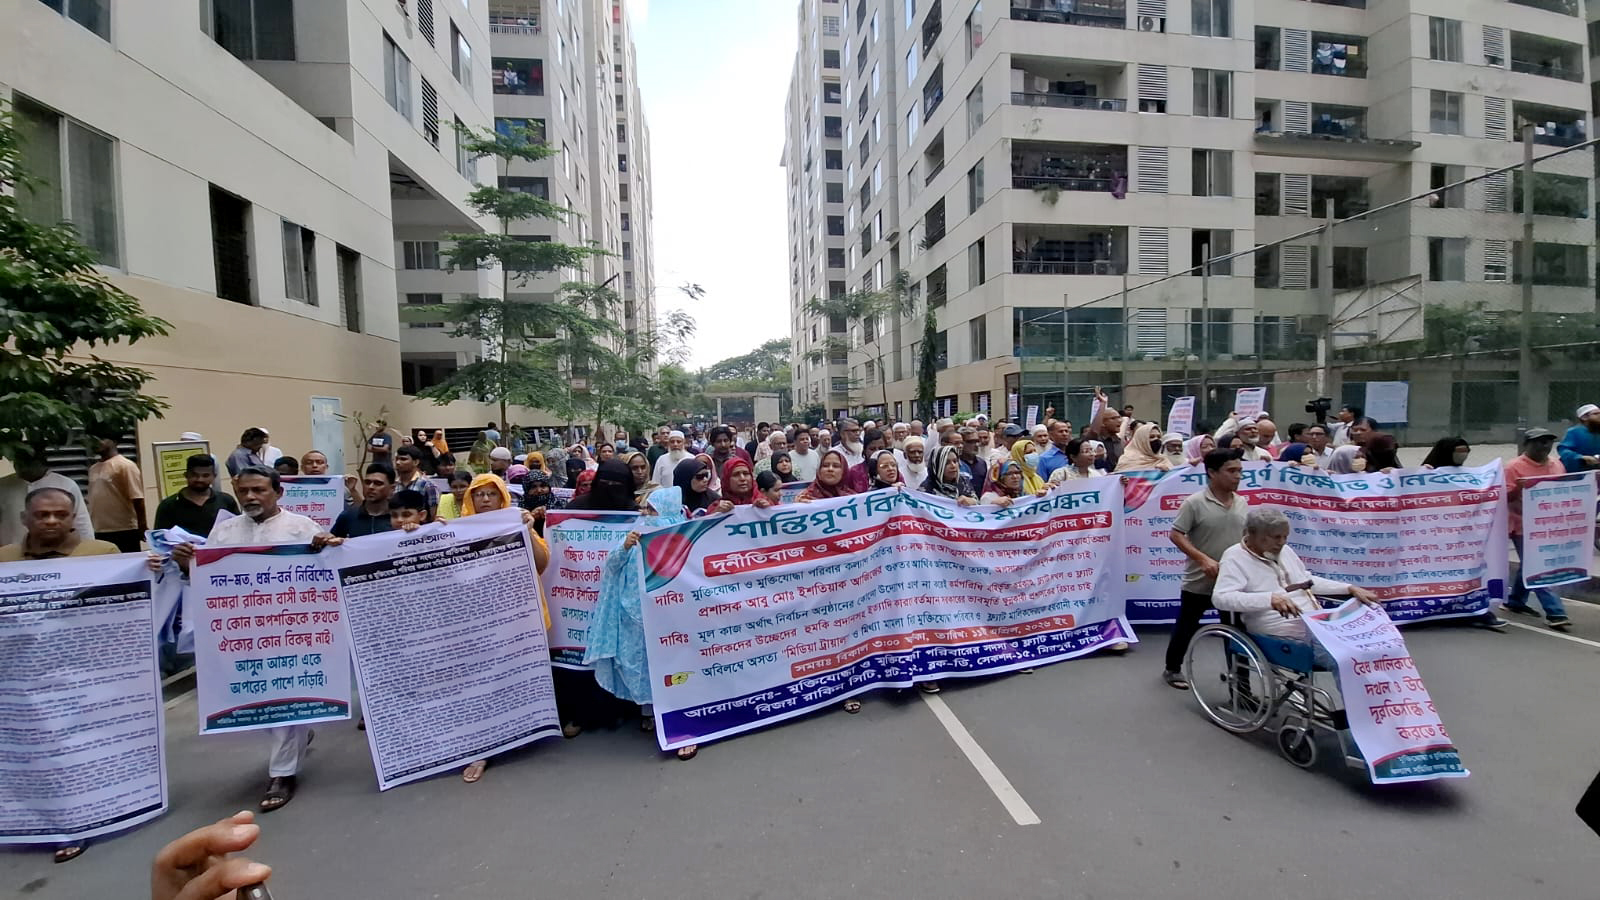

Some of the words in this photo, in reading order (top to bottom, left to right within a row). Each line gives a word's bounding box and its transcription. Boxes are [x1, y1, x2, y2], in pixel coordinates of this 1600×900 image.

[724, 498, 858, 538] শান্তিপূর্ণ
[964, 511, 985, 523] ও
[425, 531, 456, 544] আলো
[587, 525, 612, 543] সমিতির
[710, 546, 806, 574] দুর্নীতিবাজ
[812, 543, 828, 553] ও
[833, 527, 886, 550] ক্ষমতার
[1050, 516, 1078, 531] বিচার
[1083, 513, 1108, 525] চাই
[586, 550, 595, 561] ৭০
[19, 572, 62, 584] আলো
[210, 573, 253, 587] দল-মত,
[295, 563, 335, 583] নির্বিশেষে
[655, 591, 685, 607] দাবিঃ
[691, 581, 741, 601] মুক্তিযোদ্ধা
[743, 581, 753, 589] ও
[756, 571, 804, 590] মুক্তিযোদ্ধা
[808, 562, 841, 579] পরিবার
[895, 544, 908, 553] ৭০
[206, 597, 239, 609] আমরা
[242, 590, 272, 608] রাকিন
[276, 586, 297, 604] বাসী
[299, 586, 338, 605] ভাই-ভাই
[698, 600, 742, 617] প্রশাসক
[745, 595, 769, 608] আবু
[773, 590, 795, 604] মোঃ
[797, 580, 847, 599] ইশতিয়াক
[210, 619, 222, 632] যে
[227, 616, 251, 630] কোন
[254, 608, 308, 628] অপশক্তিকে
[312, 610, 340, 624] রুখতে
[660, 632, 689, 647] দাবিঃ
[697, 630, 716, 643] মূল
[719, 623, 742, 636] কাজ
[745, 616, 773, 630] অর্থাৎ
[775, 609, 808, 625] নির্বাচন
[811, 599, 854, 618] অনুষ্ঠানের
[218, 636, 253, 652] ঐক্যের
[257, 635, 281, 650] কোন
[285, 629, 312, 647] বিকল্প
[700, 638, 752, 657] মালিকদের
[755, 628, 797, 646] উচ্ছেদের
[804, 620, 830, 634] হুমকি
[701, 660, 744, 677] অবিলম্বে
[747, 651, 778, 667] অসত্য
[861, 620, 880, 636] মিথ্যা
[235, 658, 263, 676] আসুন
[267, 654, 298, 670] আমরা
[301, 653, 322, 666] একে
[786, 666, 855, 694] মুক্তিযোদ্ধা
[860, 659, 871, 669] ও
[1010, 641, 1019, 650] ও
[1021, 632, 1047, 647] ফ্ল্যাট
[795, 659, 832, 673] সময়ঃ
[836, 644, 869, 664] বিকাল
[230, 680, 267, 695] অপরের
[271, 675, 294, 691] পাশে
[1364, 681, 1391, 696] দখল
[754, 695, 798, 715] বিজয়
[801, 684, 846, 702] রাকিন
[1369, 697, 1424, 724] দূরভিসন্ধি
[1396, 724, 1436, 740] করতে
